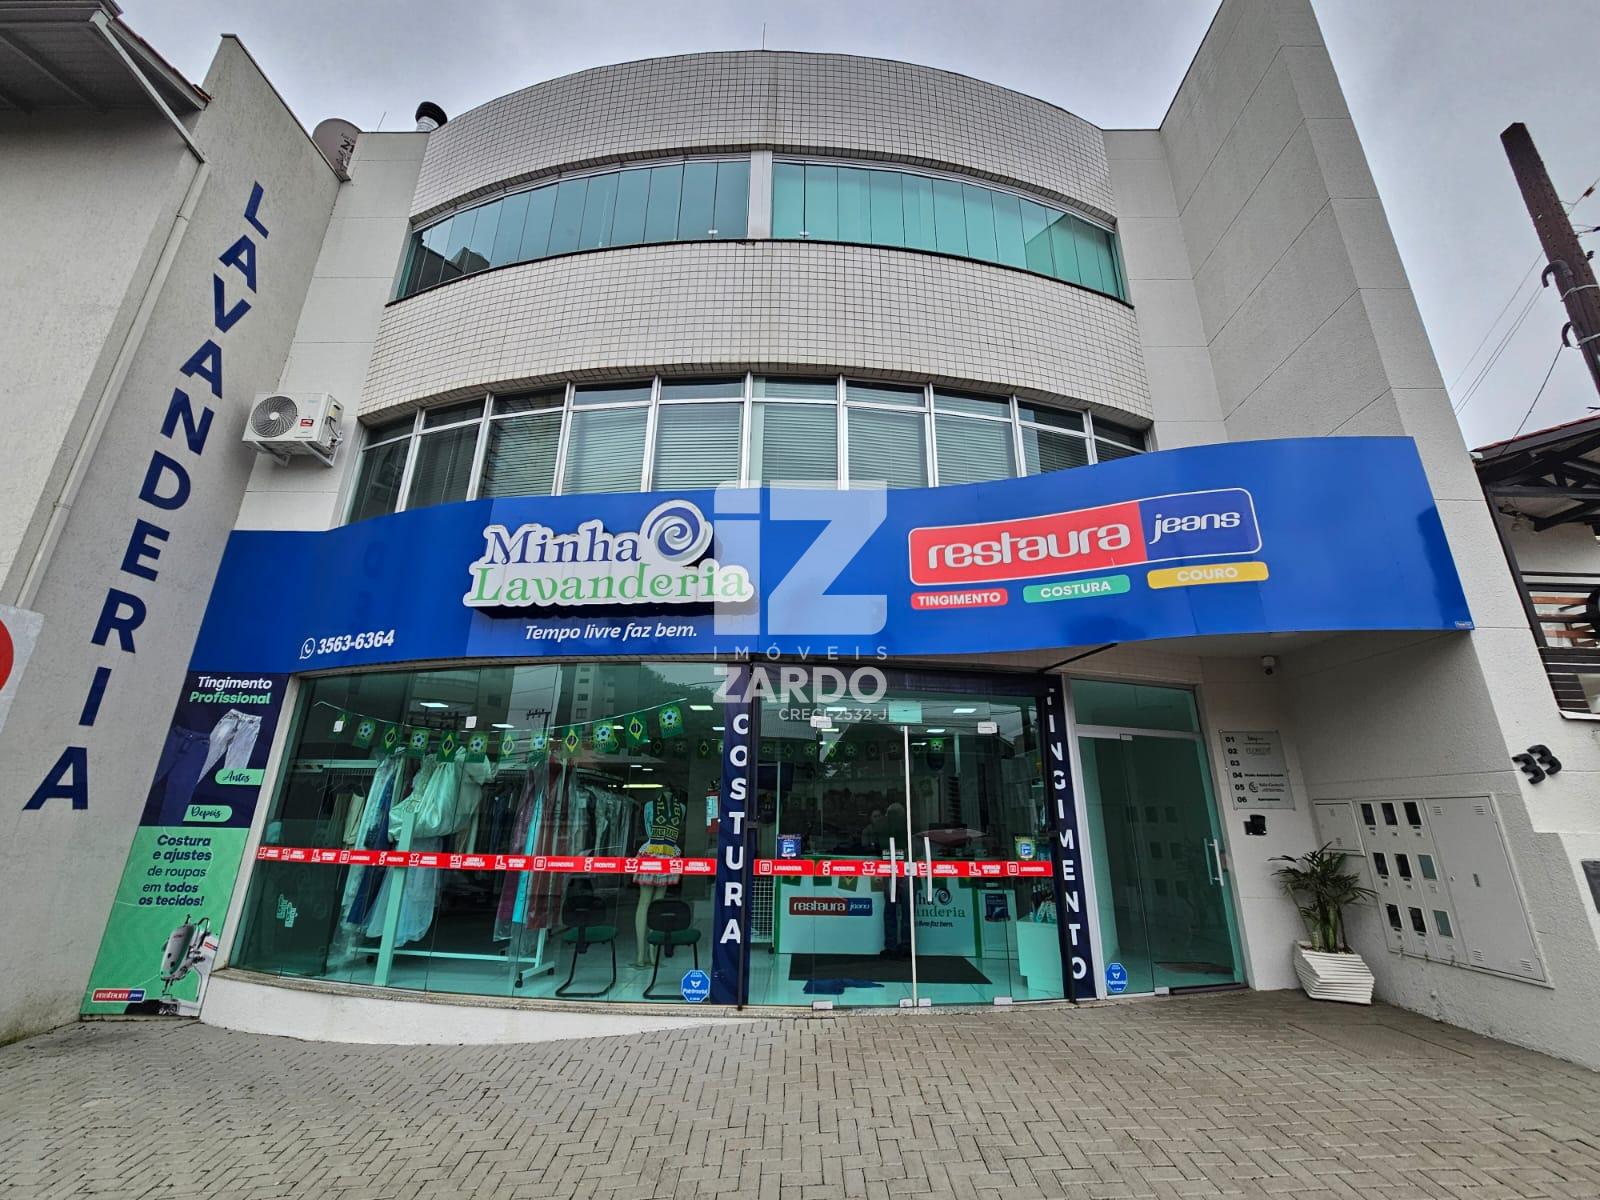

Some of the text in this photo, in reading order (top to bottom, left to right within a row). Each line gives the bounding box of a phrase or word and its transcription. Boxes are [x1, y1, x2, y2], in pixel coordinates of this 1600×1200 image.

[23, 181, 269, 811] LAVANDERIA
[486, 524, 641, 565] Minha
[928, 510, 1241, 569] restaura jeans
[470, 563, 747, 601] Lavanderia
[1176, 565, 1239, 582] COURO
[1040, 580, 1111, 599] COSTURA
[917, 592, 1001, 607] TINGIMENTO
[525, 622, 698, 643] Tempo livre faz bem.
[317, 630, 395, 654] 3563-6364
[197, 675, 273, 692] Tingimento
[188, 691, 272, 705] Profissional
[1512, 744, 1562, 785] 33
[223, 771, 251, 783] Antes
[191, 806, 222, 819] Depois
[720, 713, 749, 944] COSTURA
[157, 834, 211, 847] Costura
[153, 848, 212, 863] e ajustes
[147, 866, 206, 879] de roupas
[143, 882, 198, 892] em todos
[138, 895, 204, 906] os tecidos!
